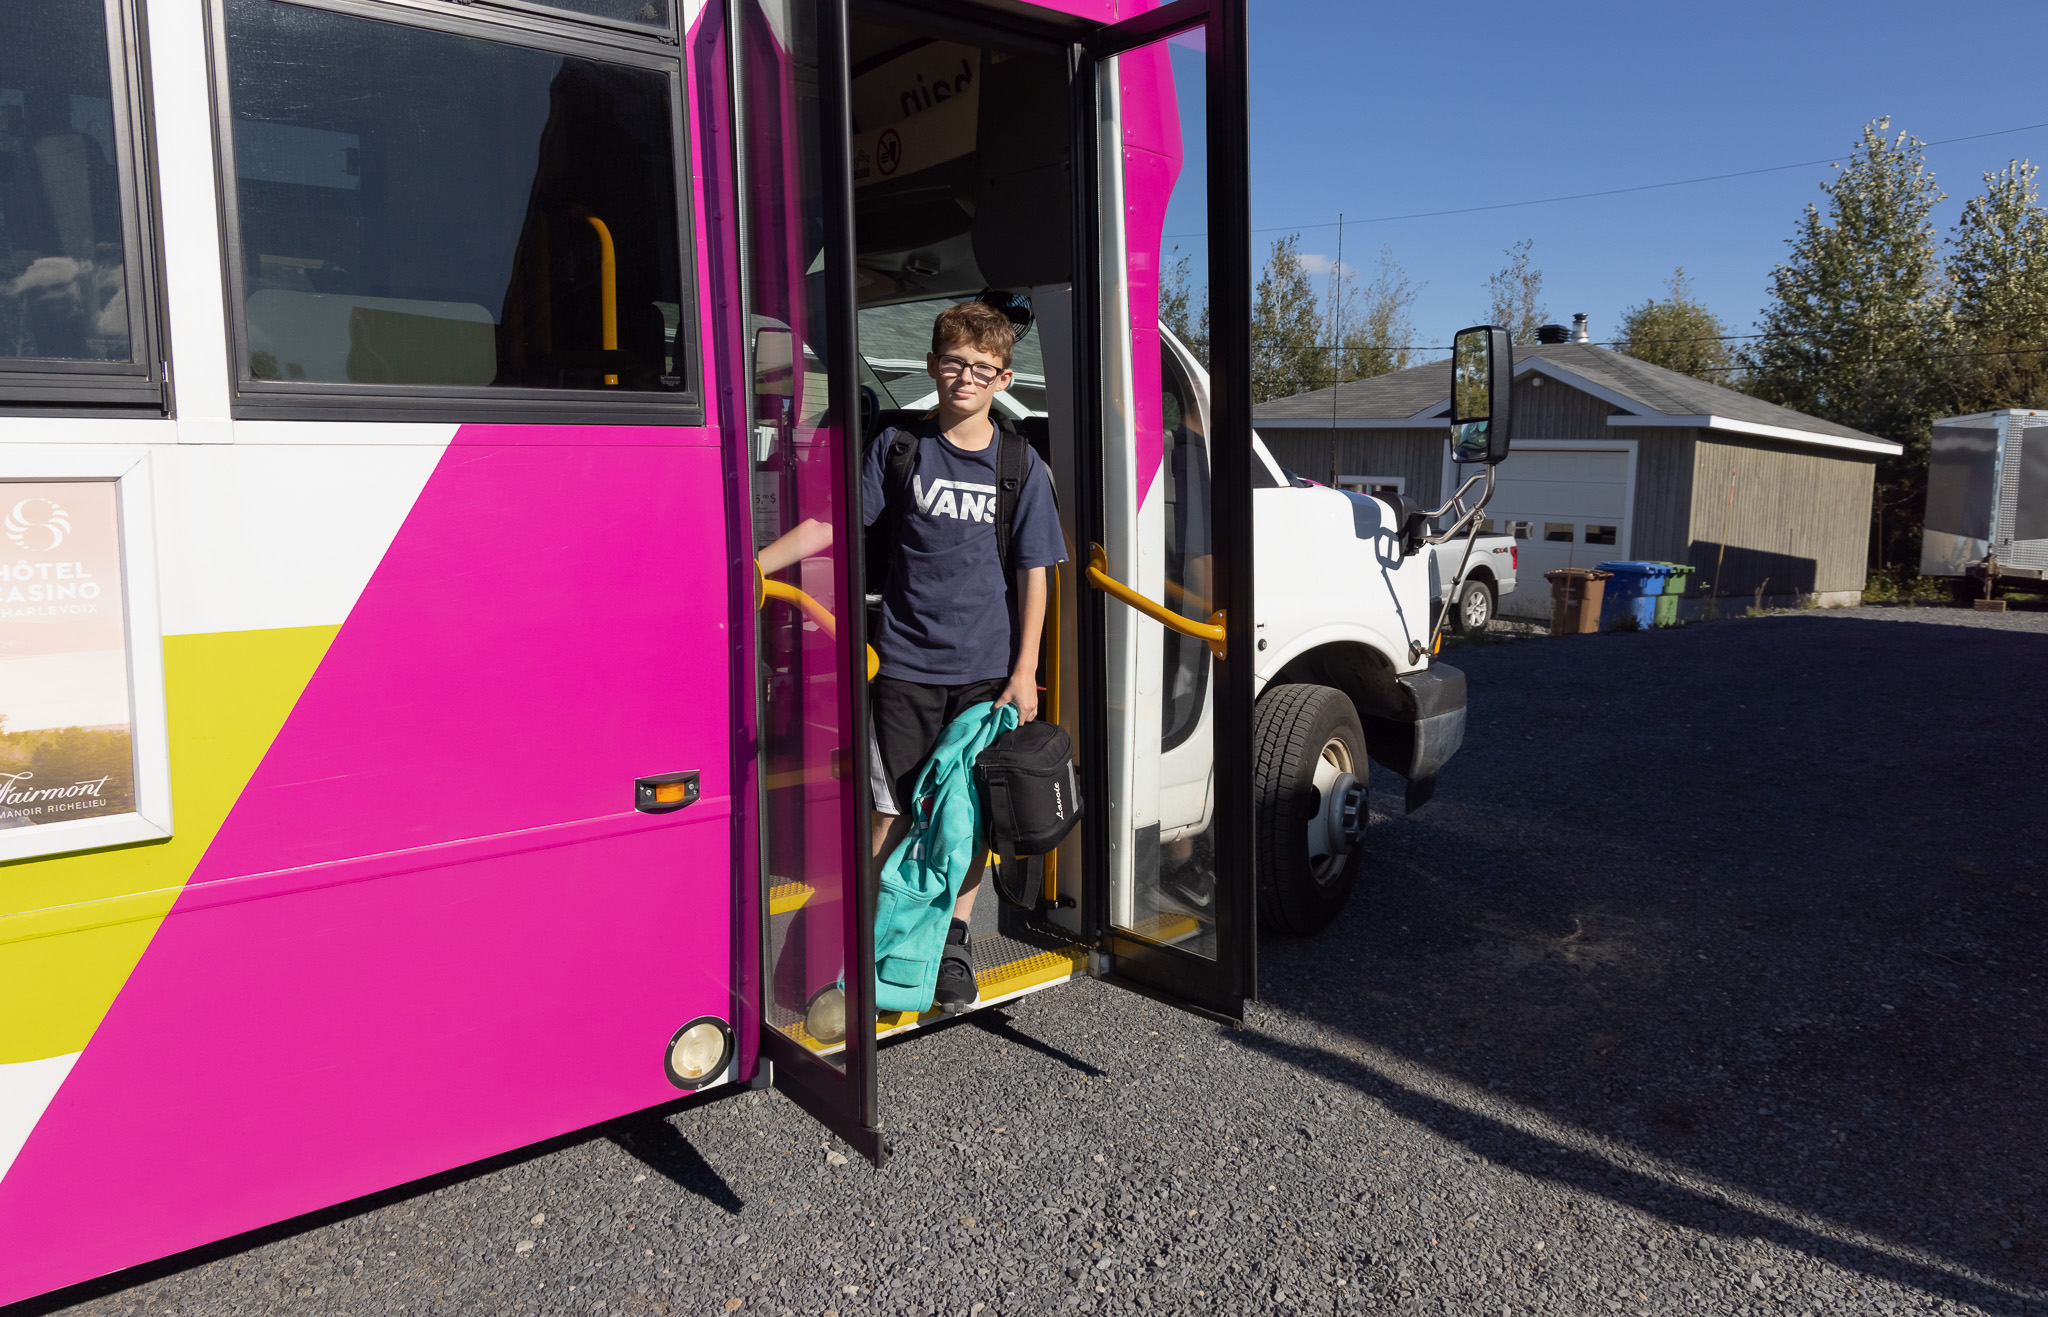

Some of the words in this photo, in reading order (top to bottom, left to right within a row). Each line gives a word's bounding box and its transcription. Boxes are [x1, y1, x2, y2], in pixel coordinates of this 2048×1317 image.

[913, 474, 996, 523] VANS
[0, 582, 100, 603] ASINO
[0, 603, 98, 618] HARLEVOIX
[47, 799, 107, 813] RICHELIEU
